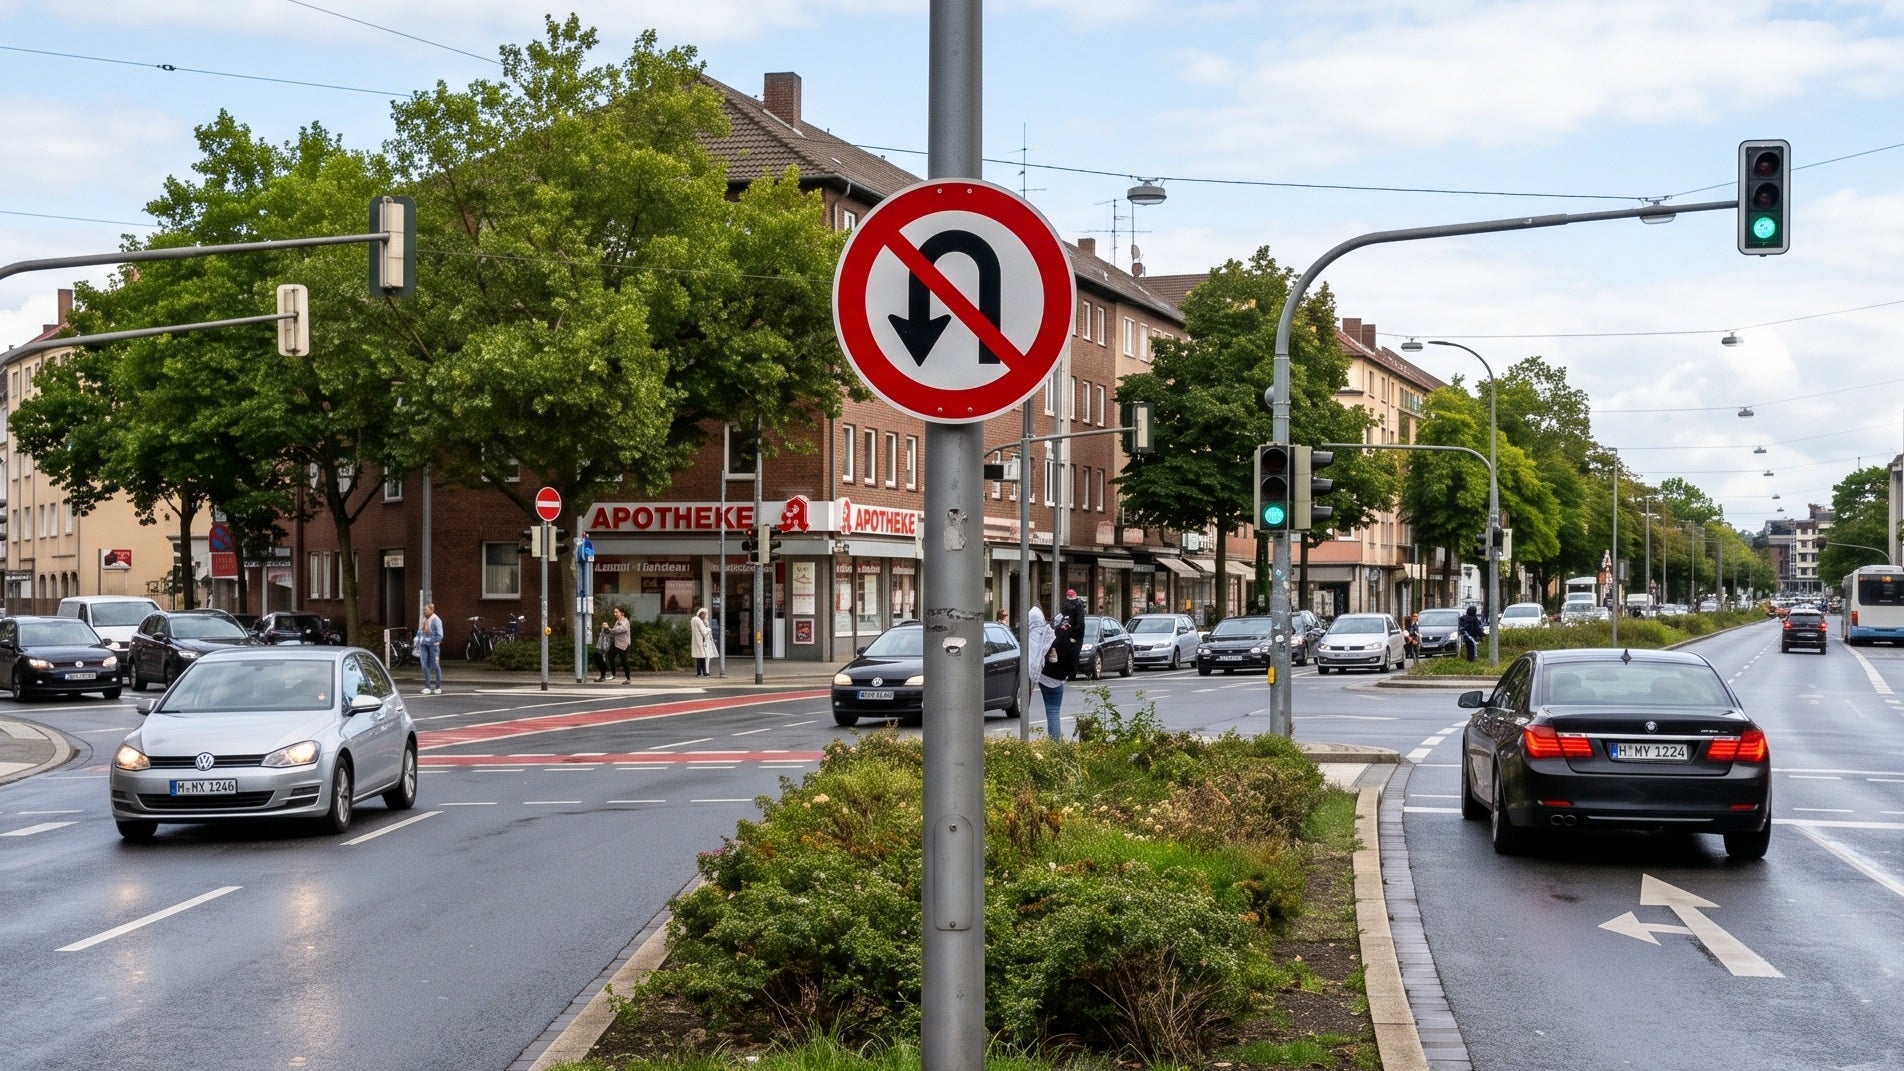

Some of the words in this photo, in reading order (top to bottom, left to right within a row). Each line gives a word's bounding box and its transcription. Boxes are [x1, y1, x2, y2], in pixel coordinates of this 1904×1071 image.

[590, 506, 754, 529] APOTHEKE
[855, 508, 916, 535] APOTHEKE
[1635, 745, 1650, 757] MY
[1655, 746, 1685, 758] 1224
[209, 781, 234, 793] 1246
